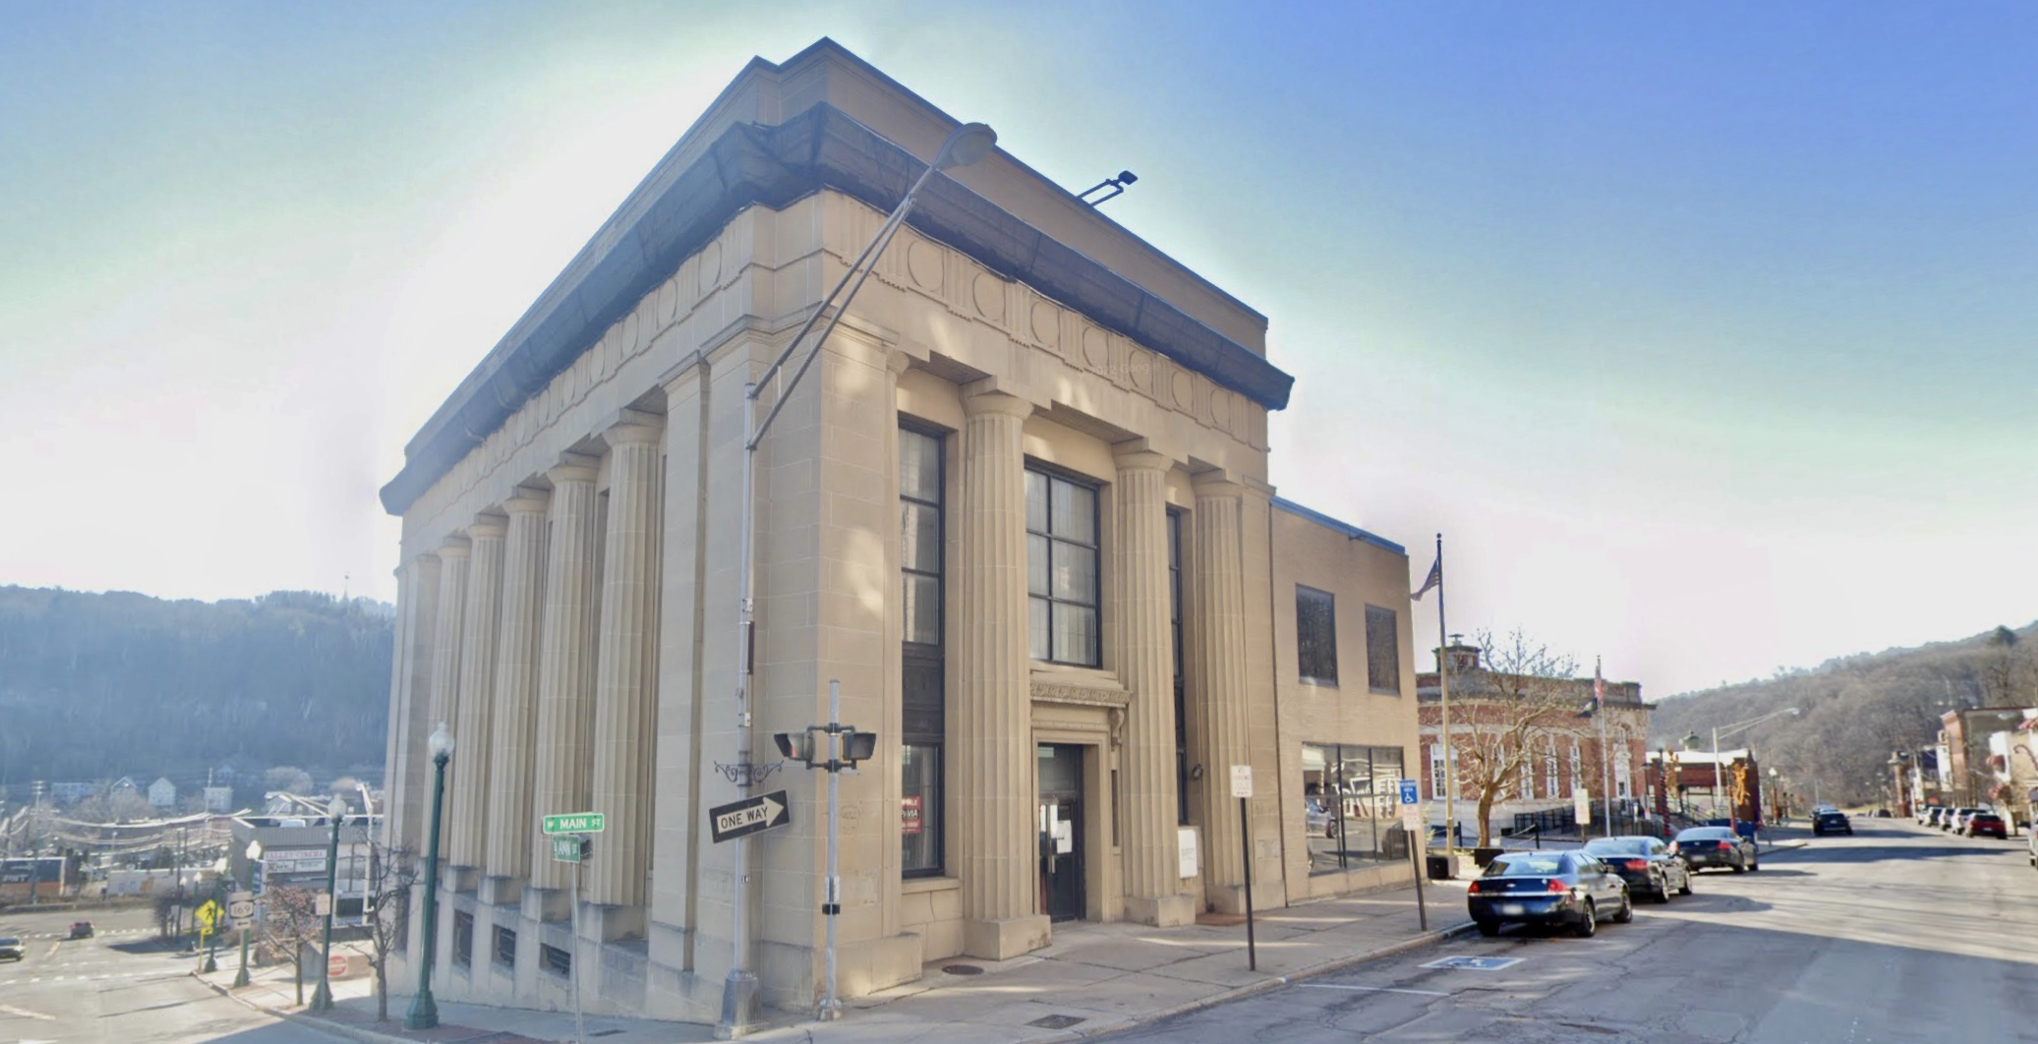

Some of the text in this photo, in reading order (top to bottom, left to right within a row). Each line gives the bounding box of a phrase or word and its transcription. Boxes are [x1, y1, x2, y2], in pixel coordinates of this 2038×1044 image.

[547, 818, 601, 829] W MAIN ST
[721, 806, 768, 829] ONE WAY
[558, 840, 571, 855] ANN
[572, 843, 578, 854] ST
[233, 904, 251, 915] 169
